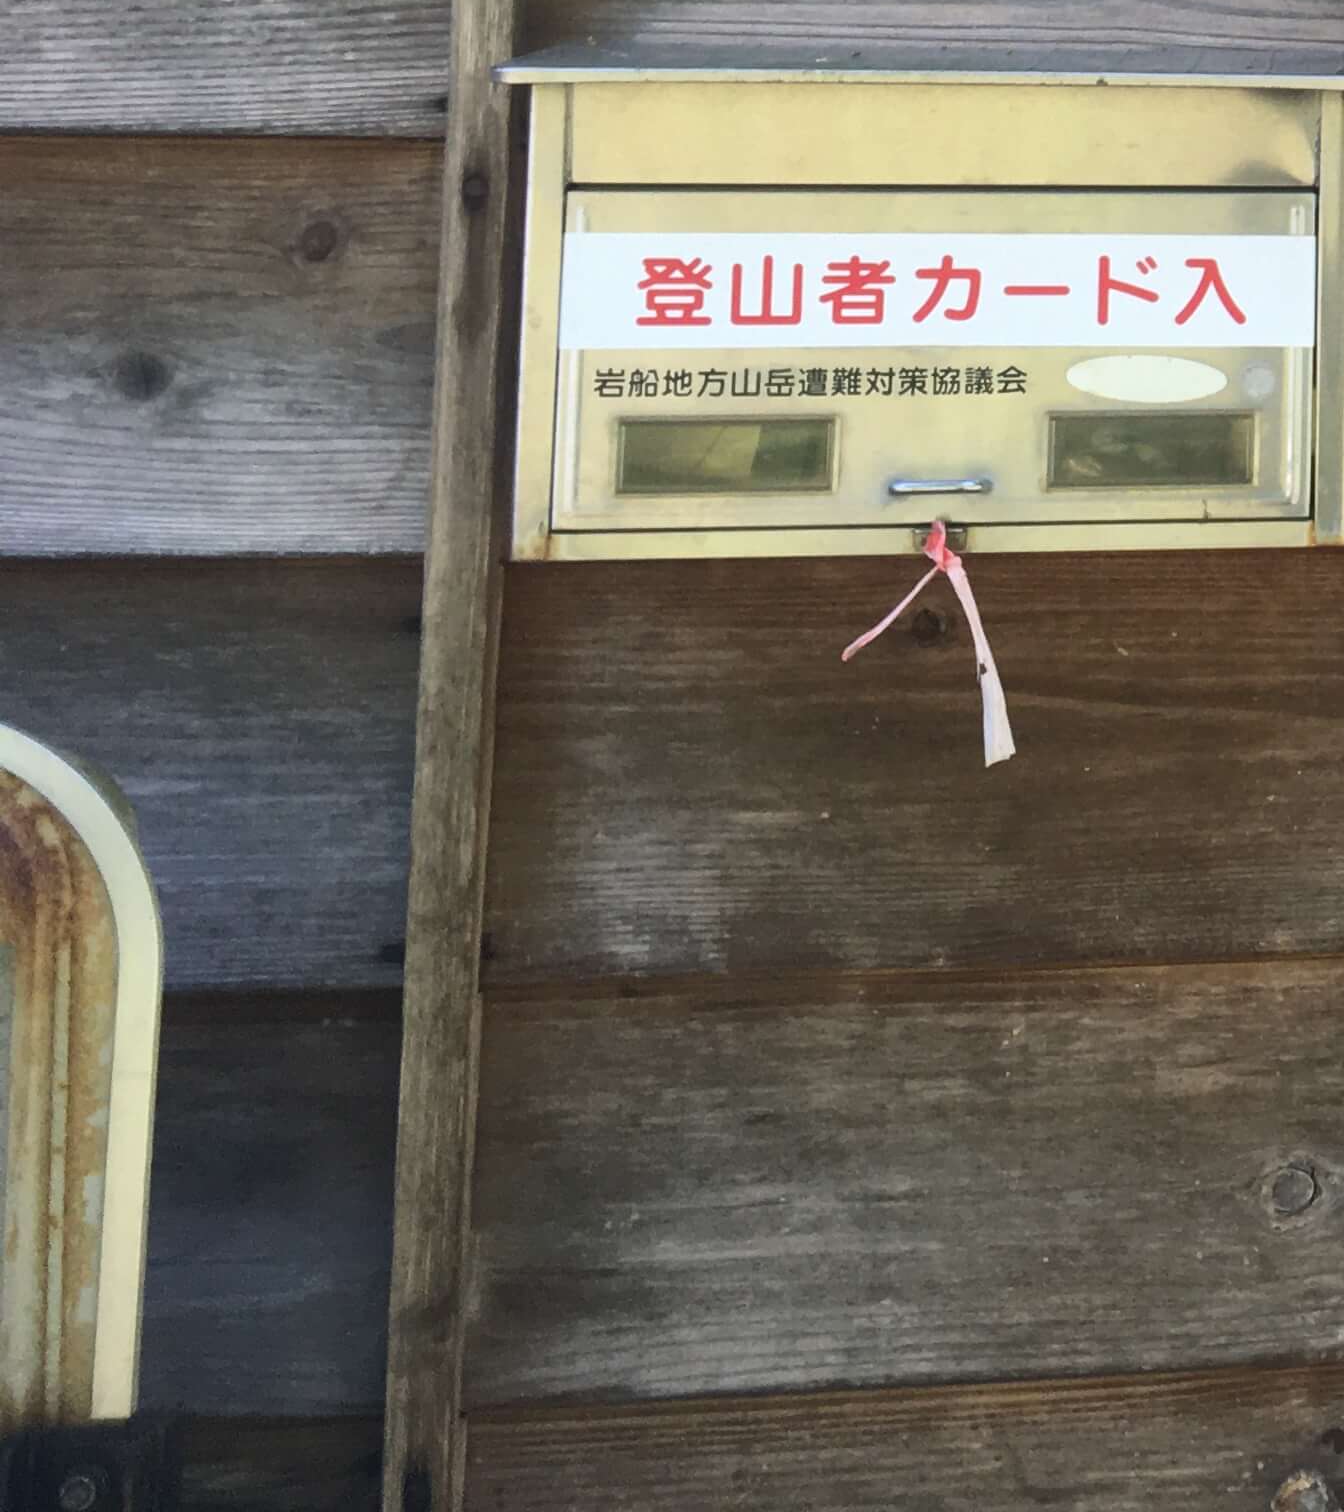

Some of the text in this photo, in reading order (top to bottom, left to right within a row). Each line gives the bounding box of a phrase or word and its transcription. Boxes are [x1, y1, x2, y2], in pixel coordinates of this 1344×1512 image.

[635, 255, 1246, 326] 登山者カード入
[593, 365, 1028, 398] 岩船地方山岳遭難対策協議会
